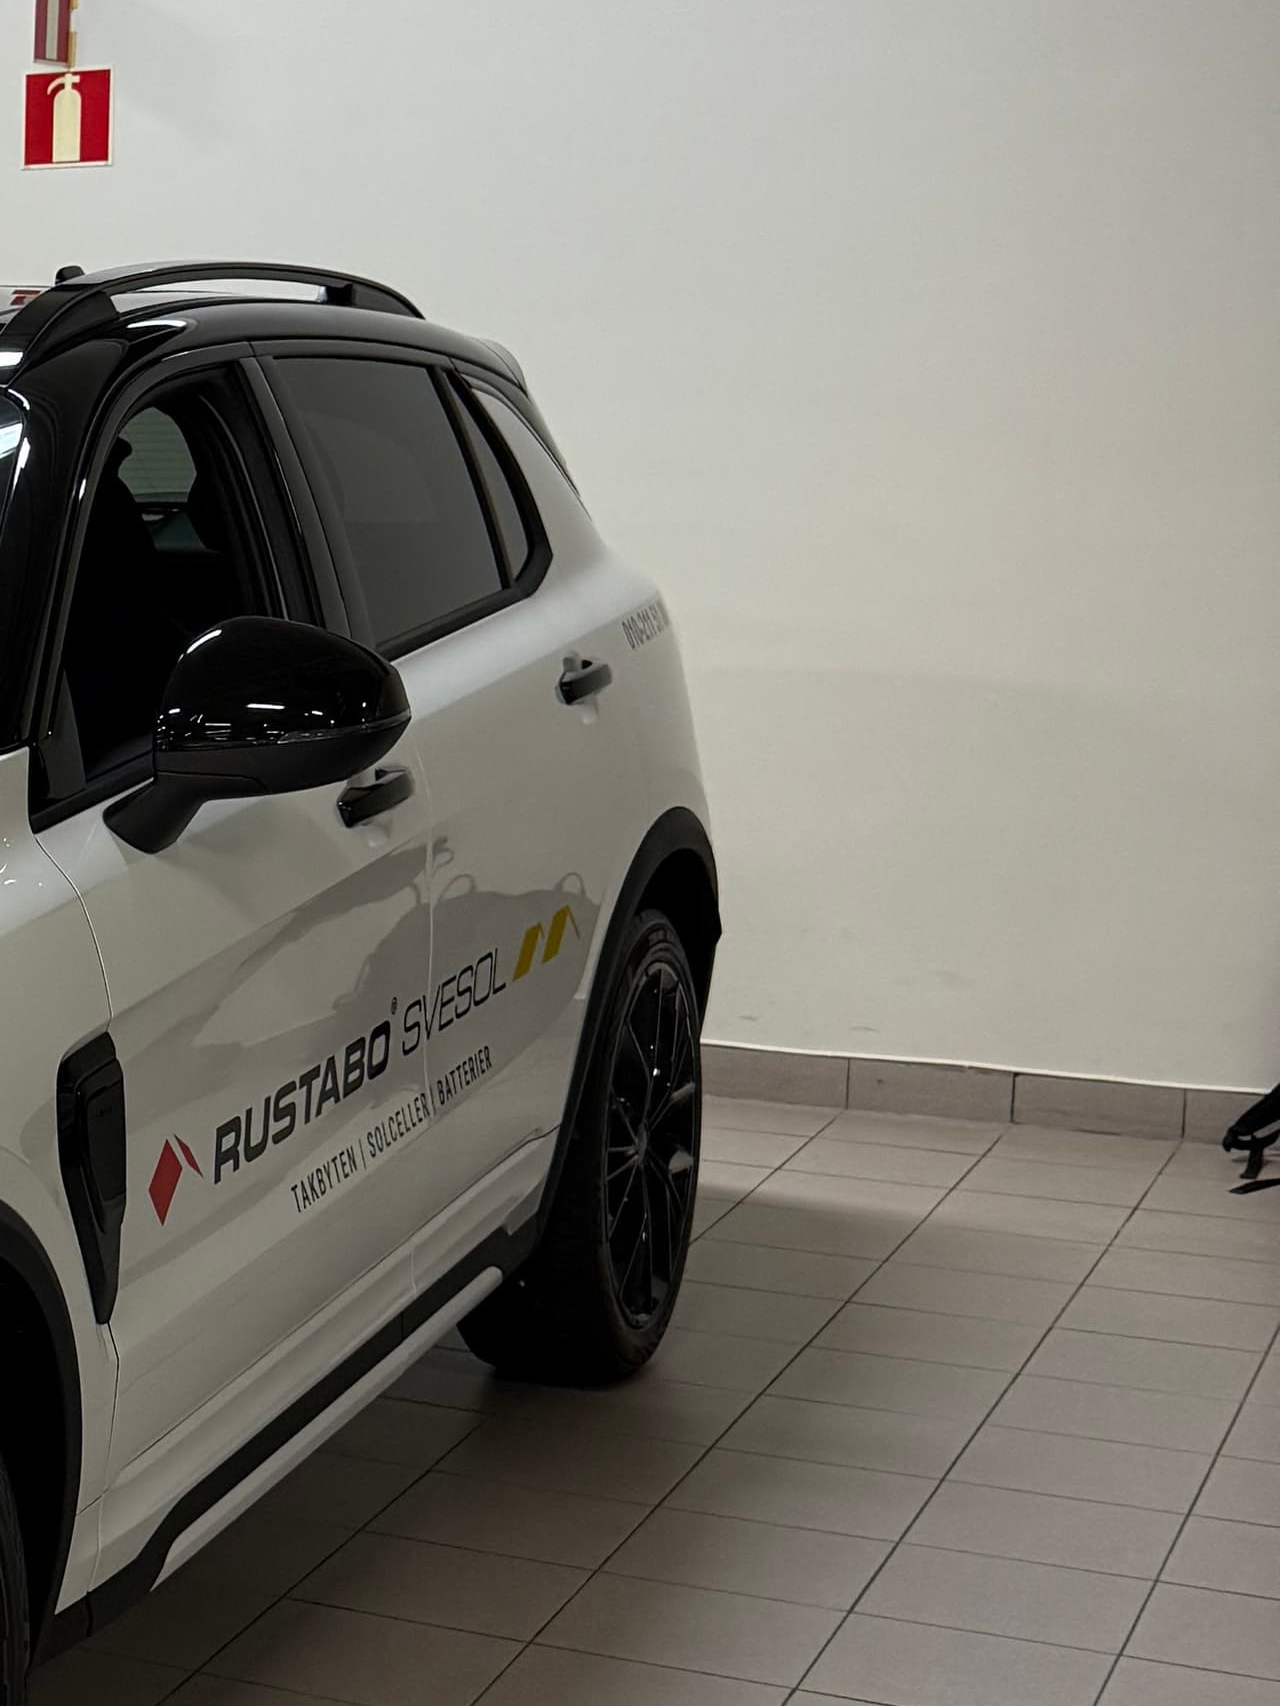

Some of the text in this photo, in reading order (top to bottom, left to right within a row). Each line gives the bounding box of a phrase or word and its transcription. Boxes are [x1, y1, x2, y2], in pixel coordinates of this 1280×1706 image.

[402, 948, 506, 1056] SVESOL
[291, 1146, 358, 1213] TAKBYTEN
[367, 1092, 430, 1157] SOLCELLER
[437, 1045, 492, 1105] BATTERIER
